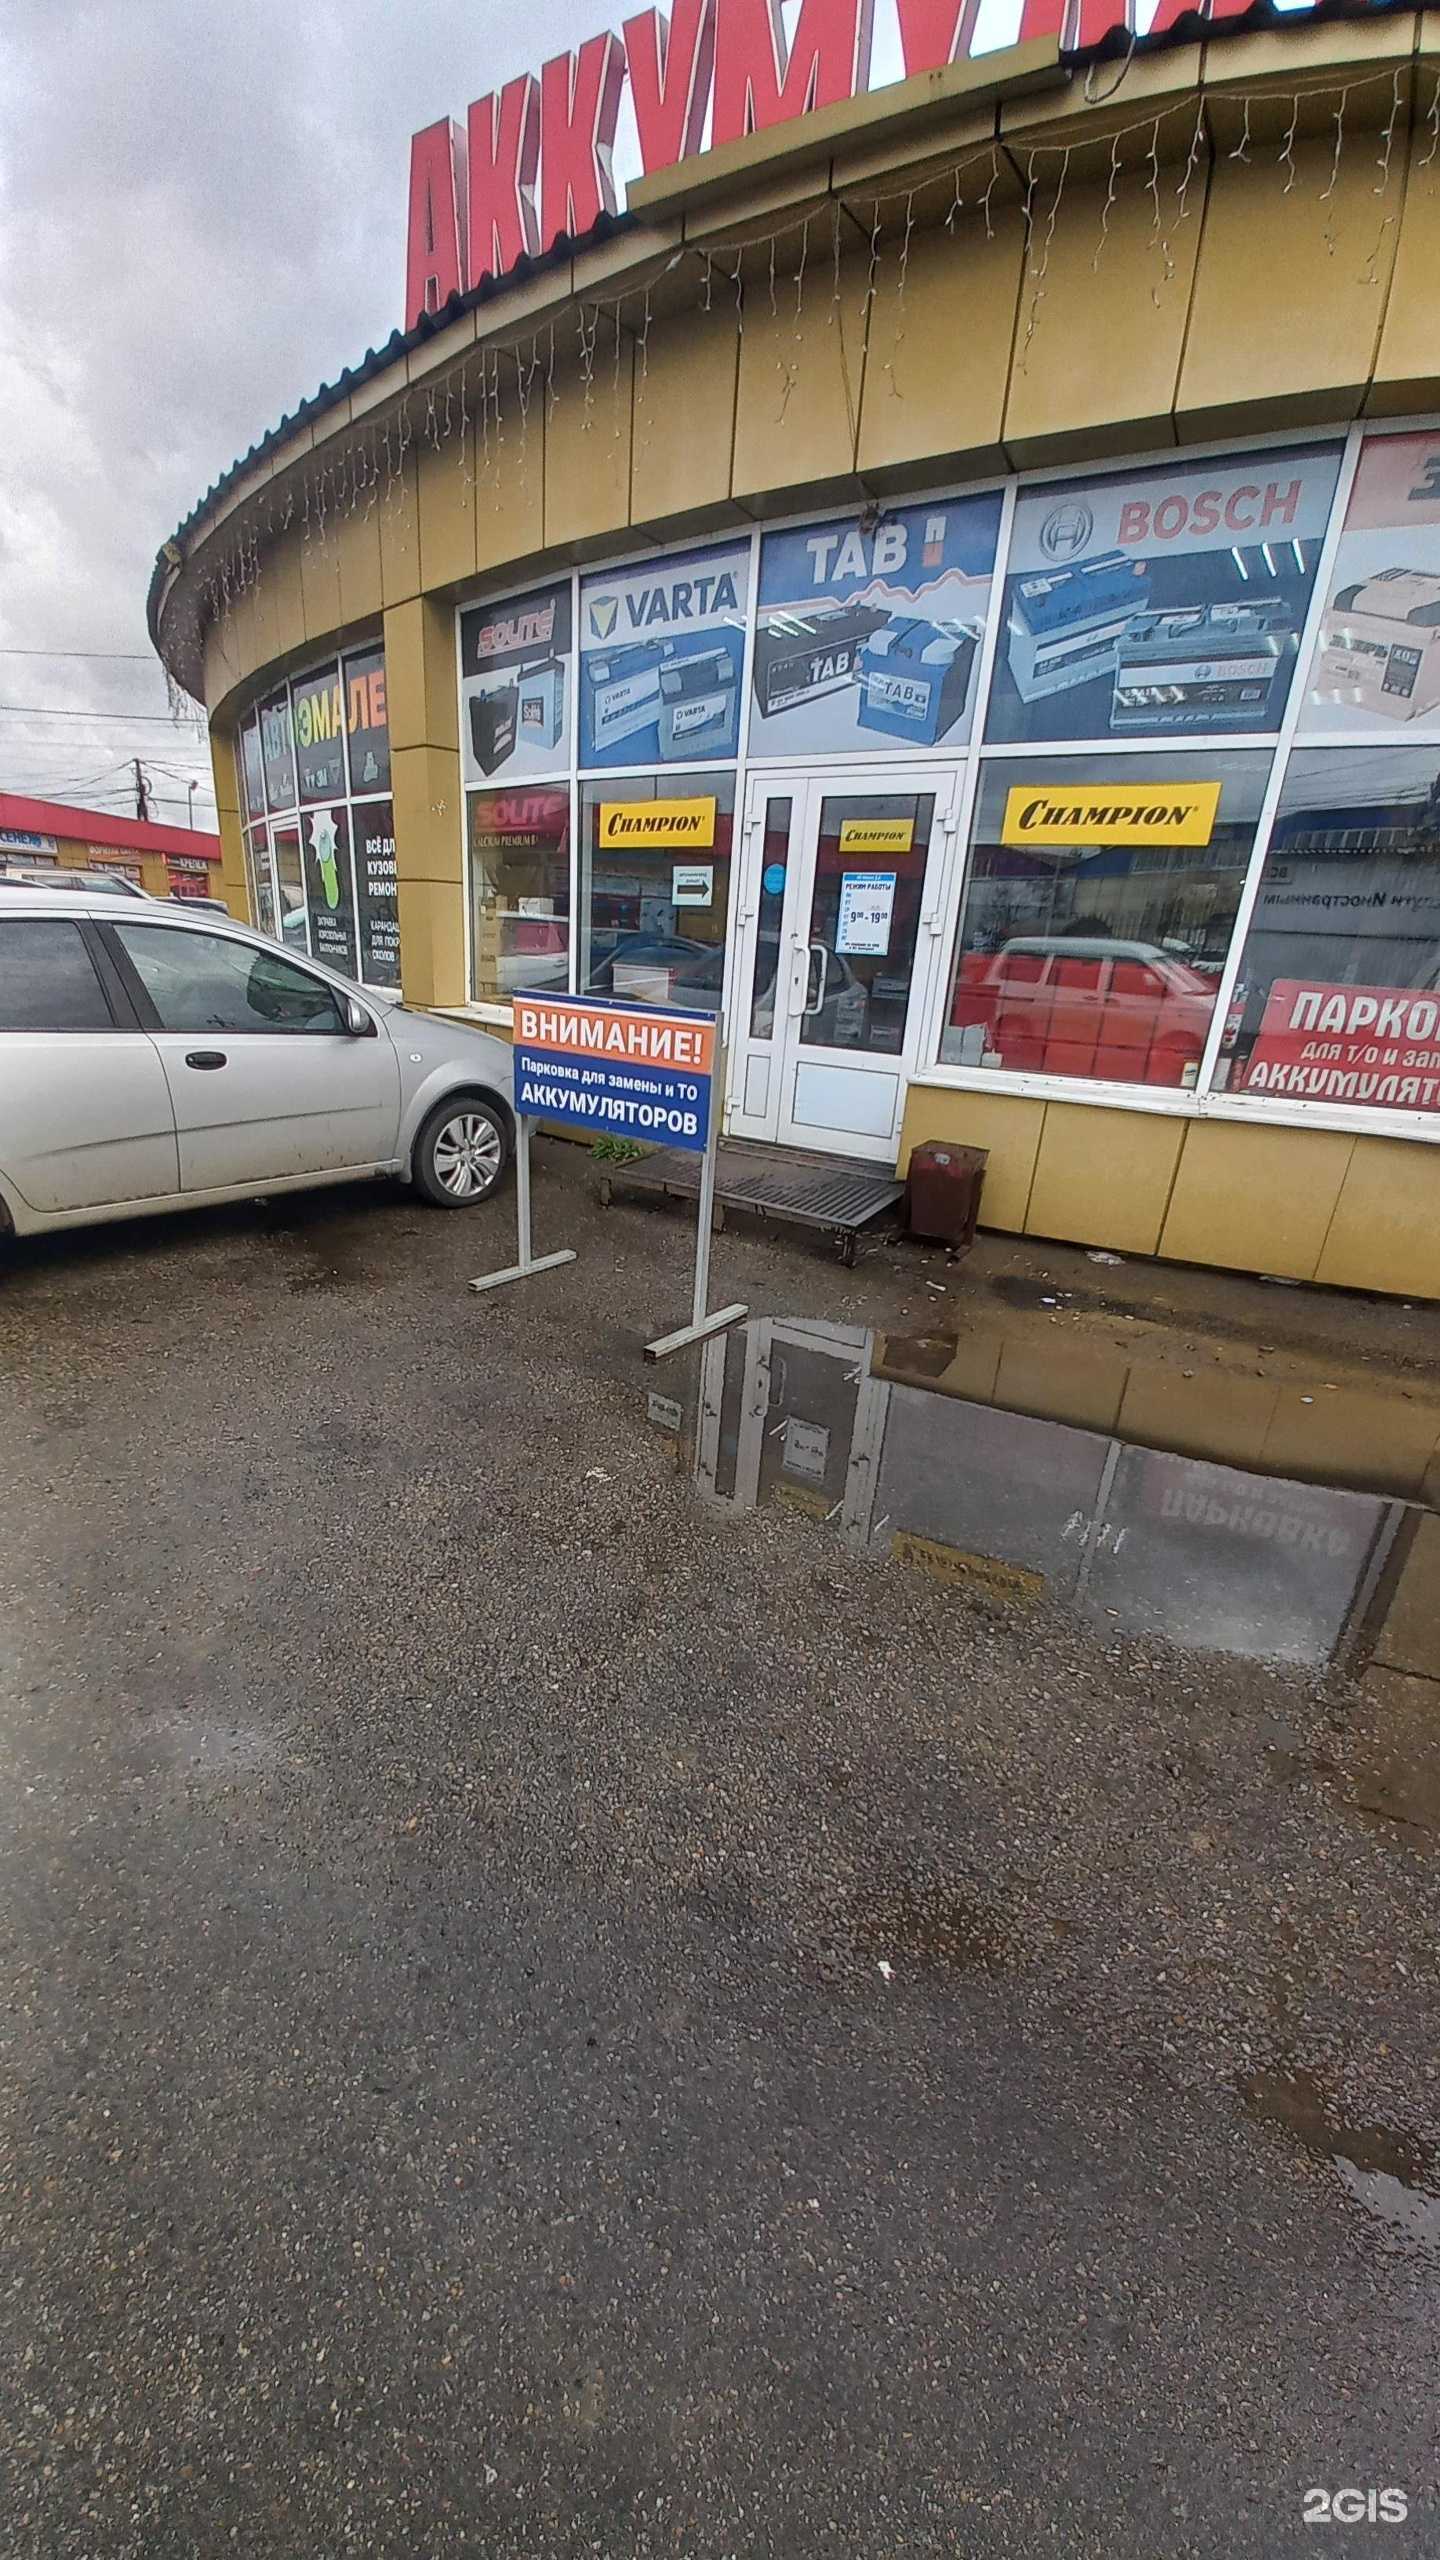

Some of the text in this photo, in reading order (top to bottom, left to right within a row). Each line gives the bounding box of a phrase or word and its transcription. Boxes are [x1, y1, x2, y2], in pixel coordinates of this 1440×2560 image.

[1117, 480, 1302, 545] BOSCH
[806, 524, 908, 584] TAB
[625, 572, 738, 628] VARTA
[810, 651, 850, 683] TAB
[884, 682, 915, 700] TAB
[608, 812, 700, 837] CHAMPION
[845, 829, 904, 842] CHAMPION
[1018, 799, 1193, 830] CHAMPION
[521, 1010, 703, 1064] ВНИМАНИЕ!
[1289, 991, 1440, 1042] ПАРКО
[1301, 1041, 1343, 1061] для
[1347, 1044, 1379, 1065] т/о
[1383, 1048, 1398, 1066] и
[521, 1057, 698, 1101] Парковка для замены и ТО
[1248, 1061, 1440, 1107] АККУМУЛЯТ
[521, 1082, 698, 1135] АККУМУЛЯТОРОВ
